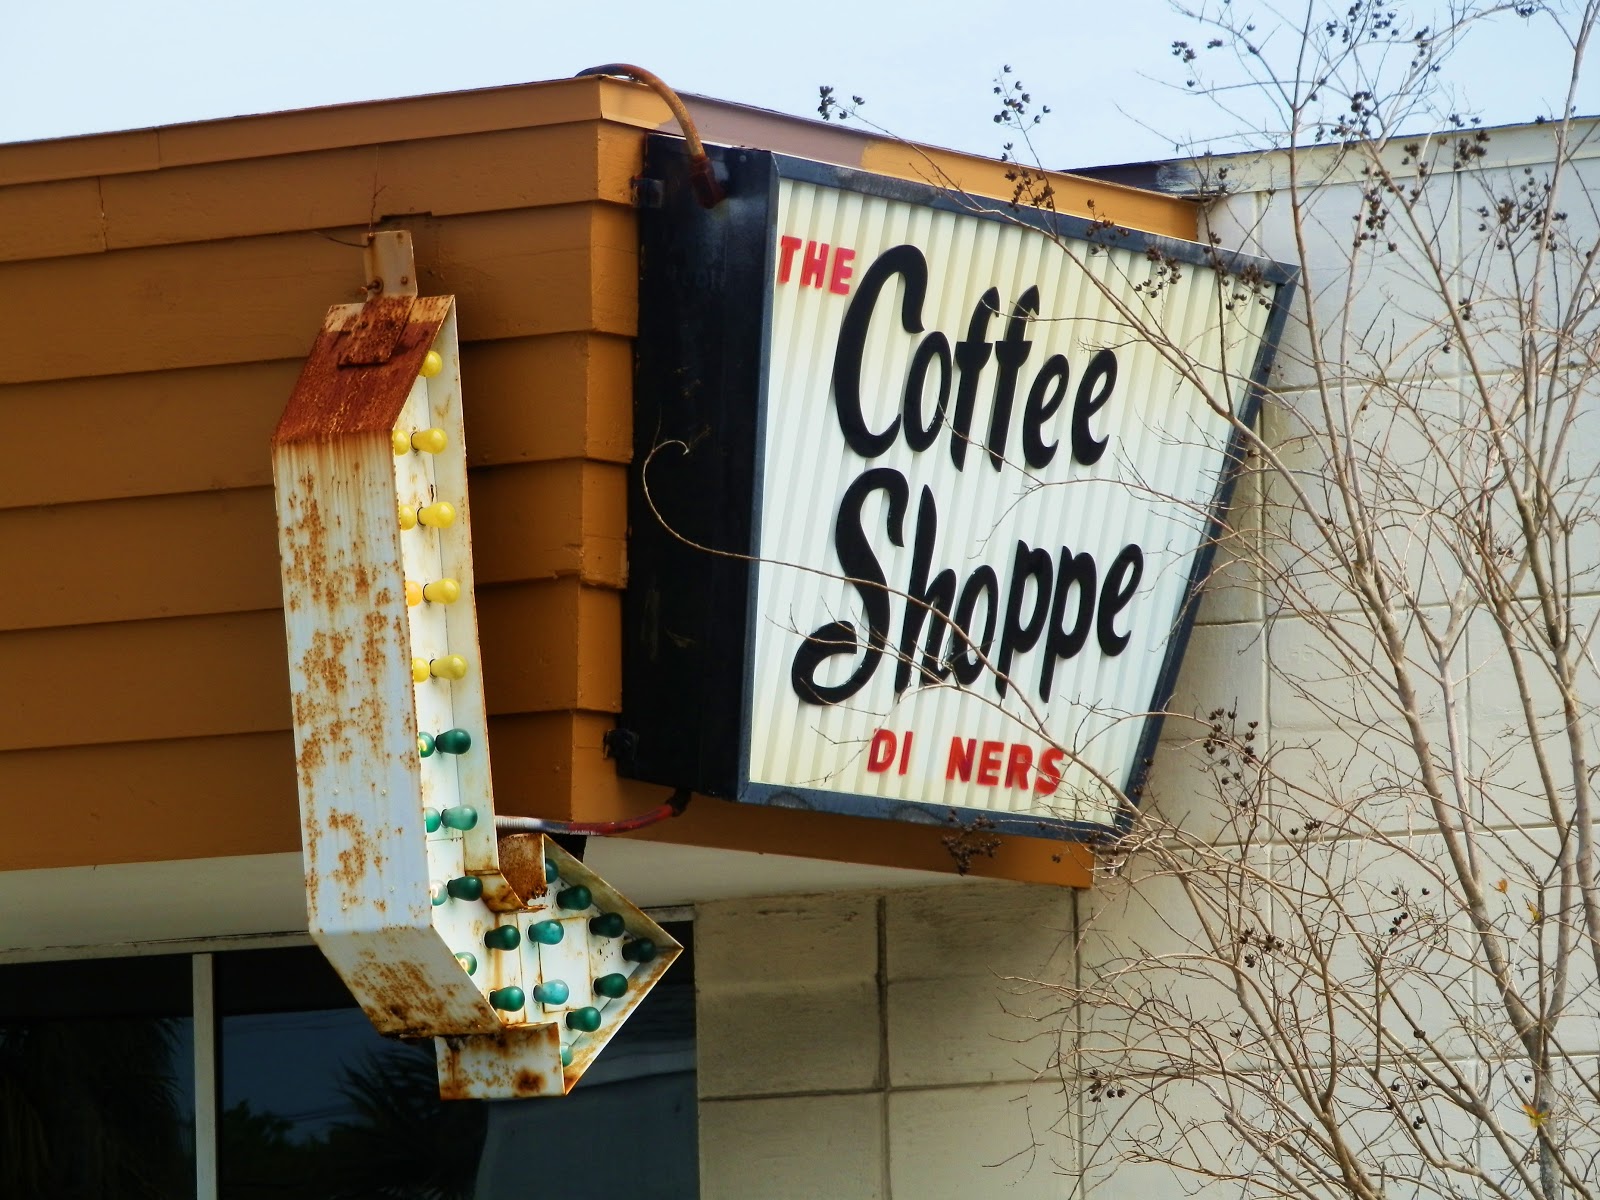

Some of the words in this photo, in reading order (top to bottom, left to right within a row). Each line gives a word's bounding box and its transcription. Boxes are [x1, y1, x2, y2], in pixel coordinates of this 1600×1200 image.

[778, 235, 855, 295] THE
[833, 244, 1118, 472] Coffee
[791, 467, 1144, 706] Shoppe
